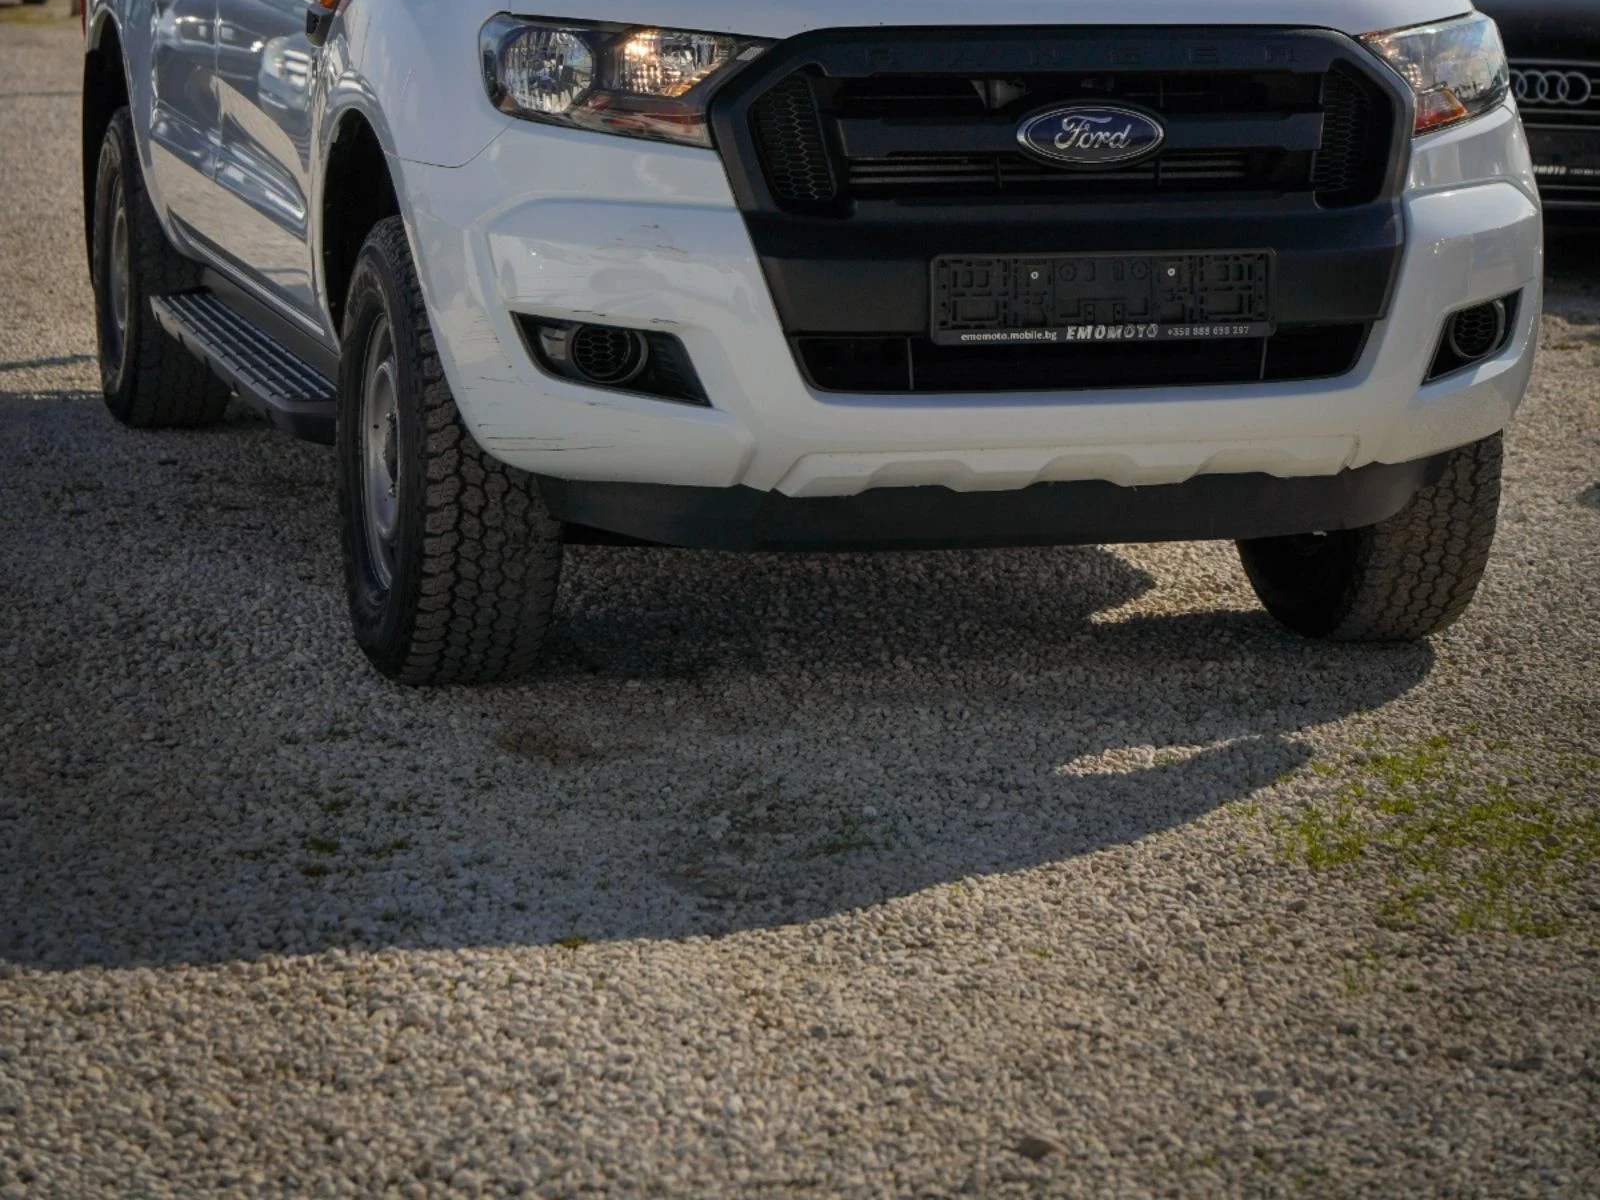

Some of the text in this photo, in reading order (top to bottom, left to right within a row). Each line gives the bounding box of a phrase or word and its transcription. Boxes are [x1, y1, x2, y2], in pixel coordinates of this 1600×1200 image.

[864, 45, 1294, 67] RANGER
[1054, 115, 1133, 149] Ford
[960, 330, 1057, 341] emomoto.mobile.bg
[1066, 323, 1159, 340] EMOMOTO
